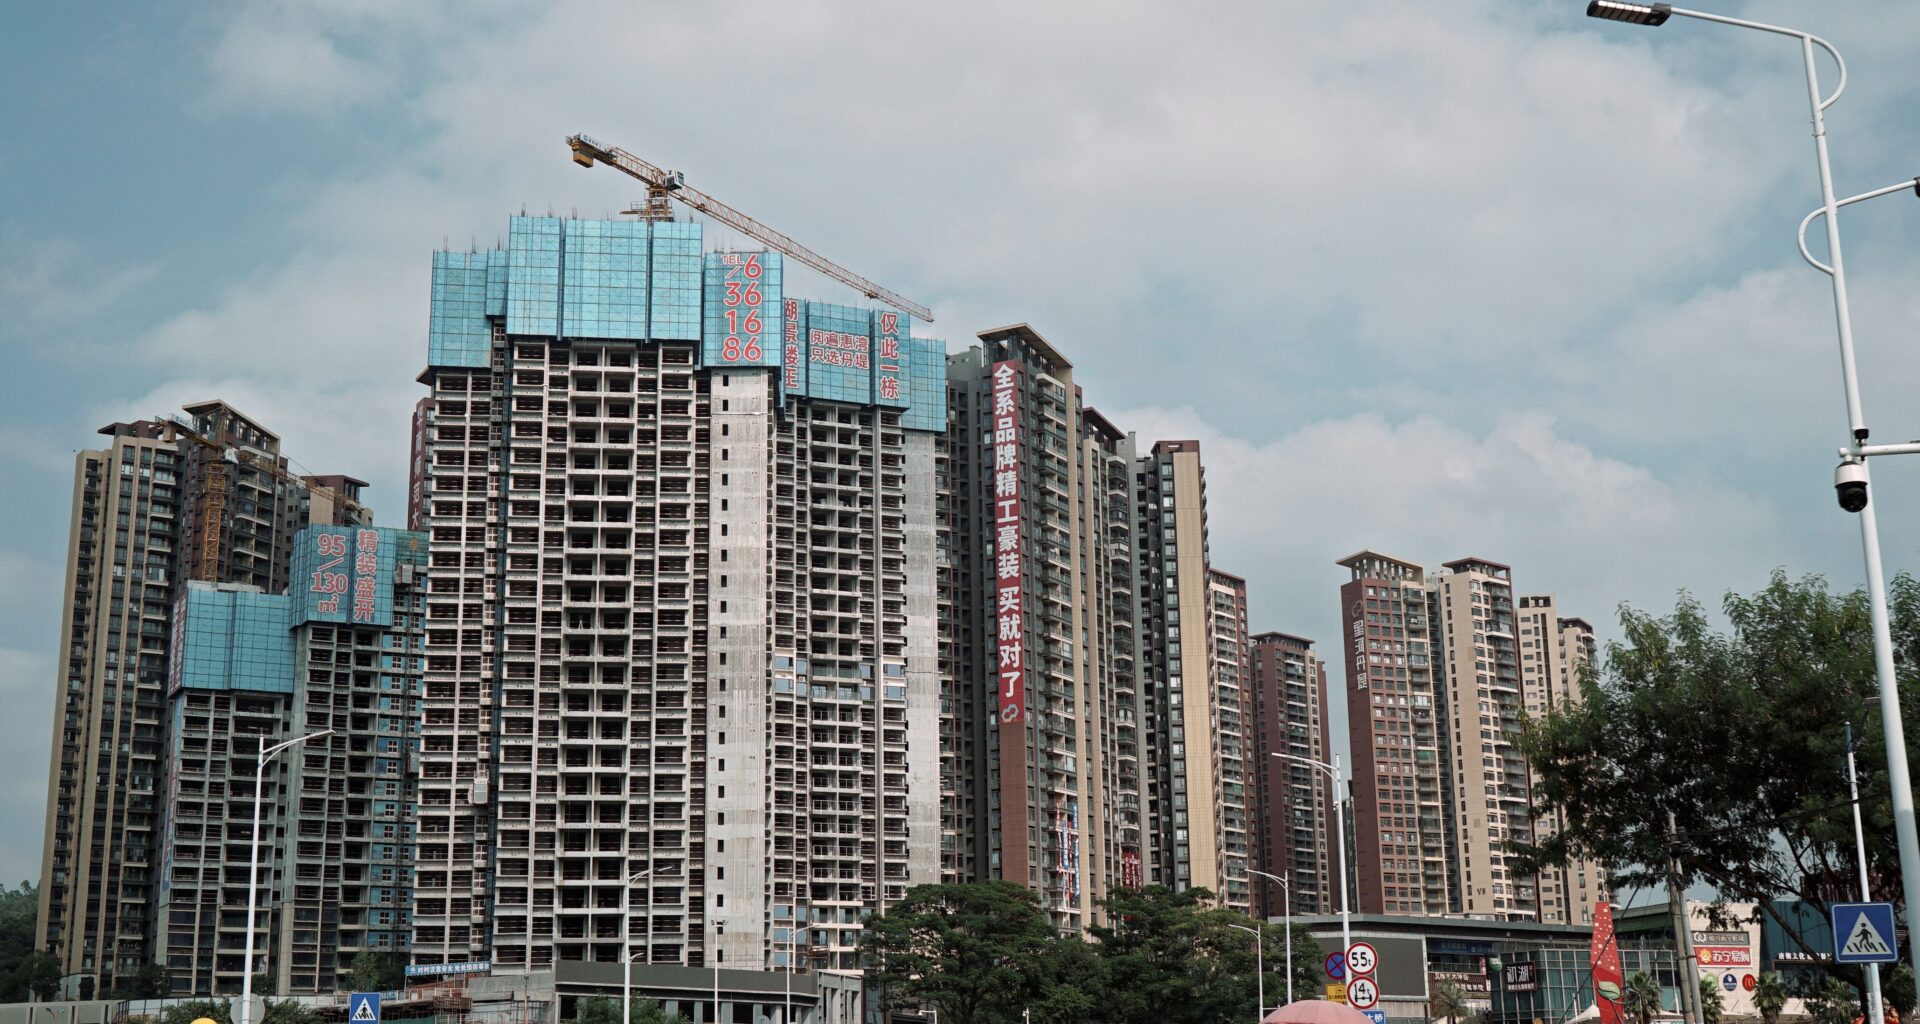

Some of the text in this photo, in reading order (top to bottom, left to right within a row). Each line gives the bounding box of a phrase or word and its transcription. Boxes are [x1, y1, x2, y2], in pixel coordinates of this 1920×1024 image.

[721, 254, 744, 266] TEL
[723, 281, 763, 307] 36
[723, 308, 763, 335] 16
[721, 336, 763, 362] 86
[810, 328, 869, 352] 阅遍惠湾
[810, 346, 870, 370] 只选丹堤
[880, 311, 900, 400] 仅此一栋
[993, 364, 1021, 698] 全系品牌精工豪装 买就对了
[317, 533, 346, 557] 95
[310, 572, 348, 594] 130
[353, 528, 379, 622] 精装盛开
[1351, 951, 1372, 968] 55t
